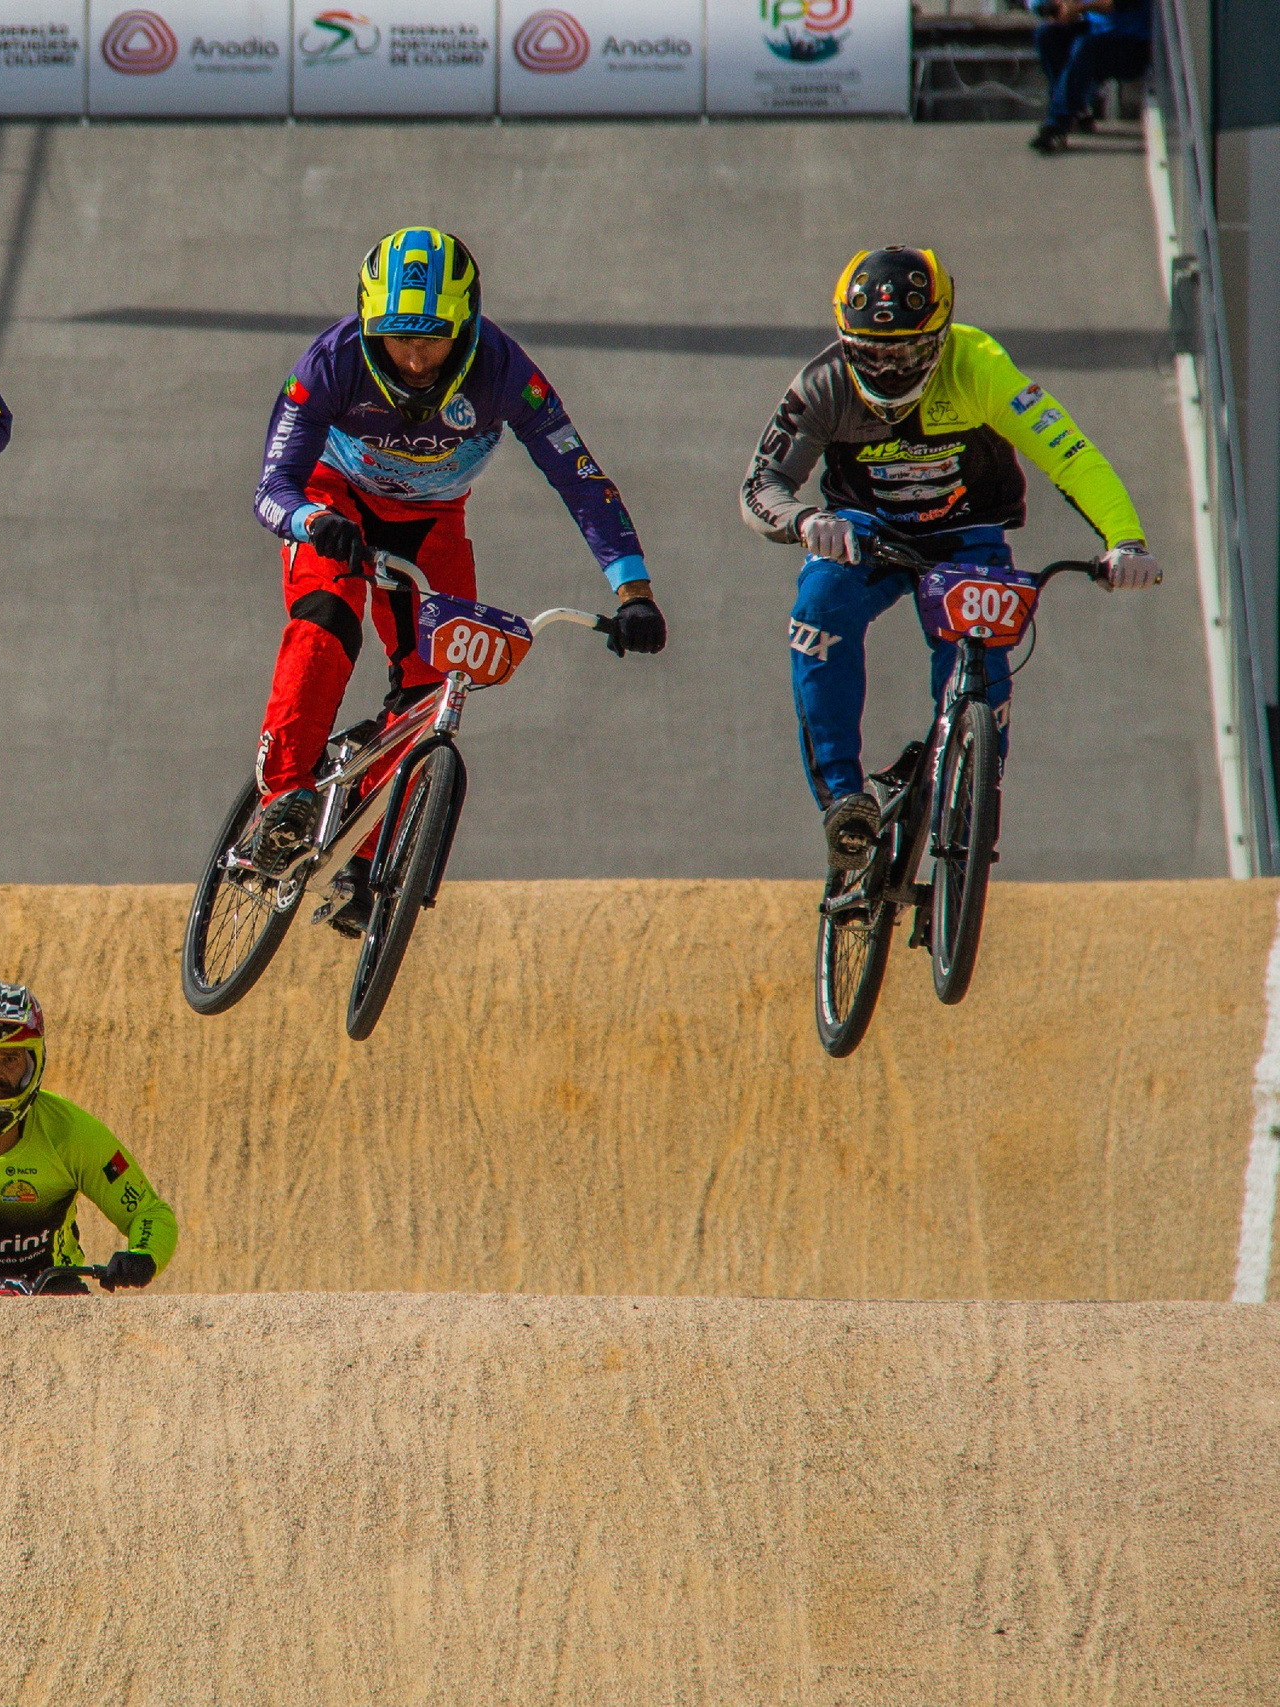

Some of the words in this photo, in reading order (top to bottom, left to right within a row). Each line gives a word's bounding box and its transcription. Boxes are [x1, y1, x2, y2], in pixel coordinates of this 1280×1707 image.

[190, 36, 280, 59] Anadia
[602, 35, 692, 58] Anadia
[859, 437, 902, 457] MS
[961, 586, 1020, 628] 802
[789, 616, 843, 661] FOX
[446, 625, 506, 677] 801
[17, 1168, 38, 1176] PACTO
